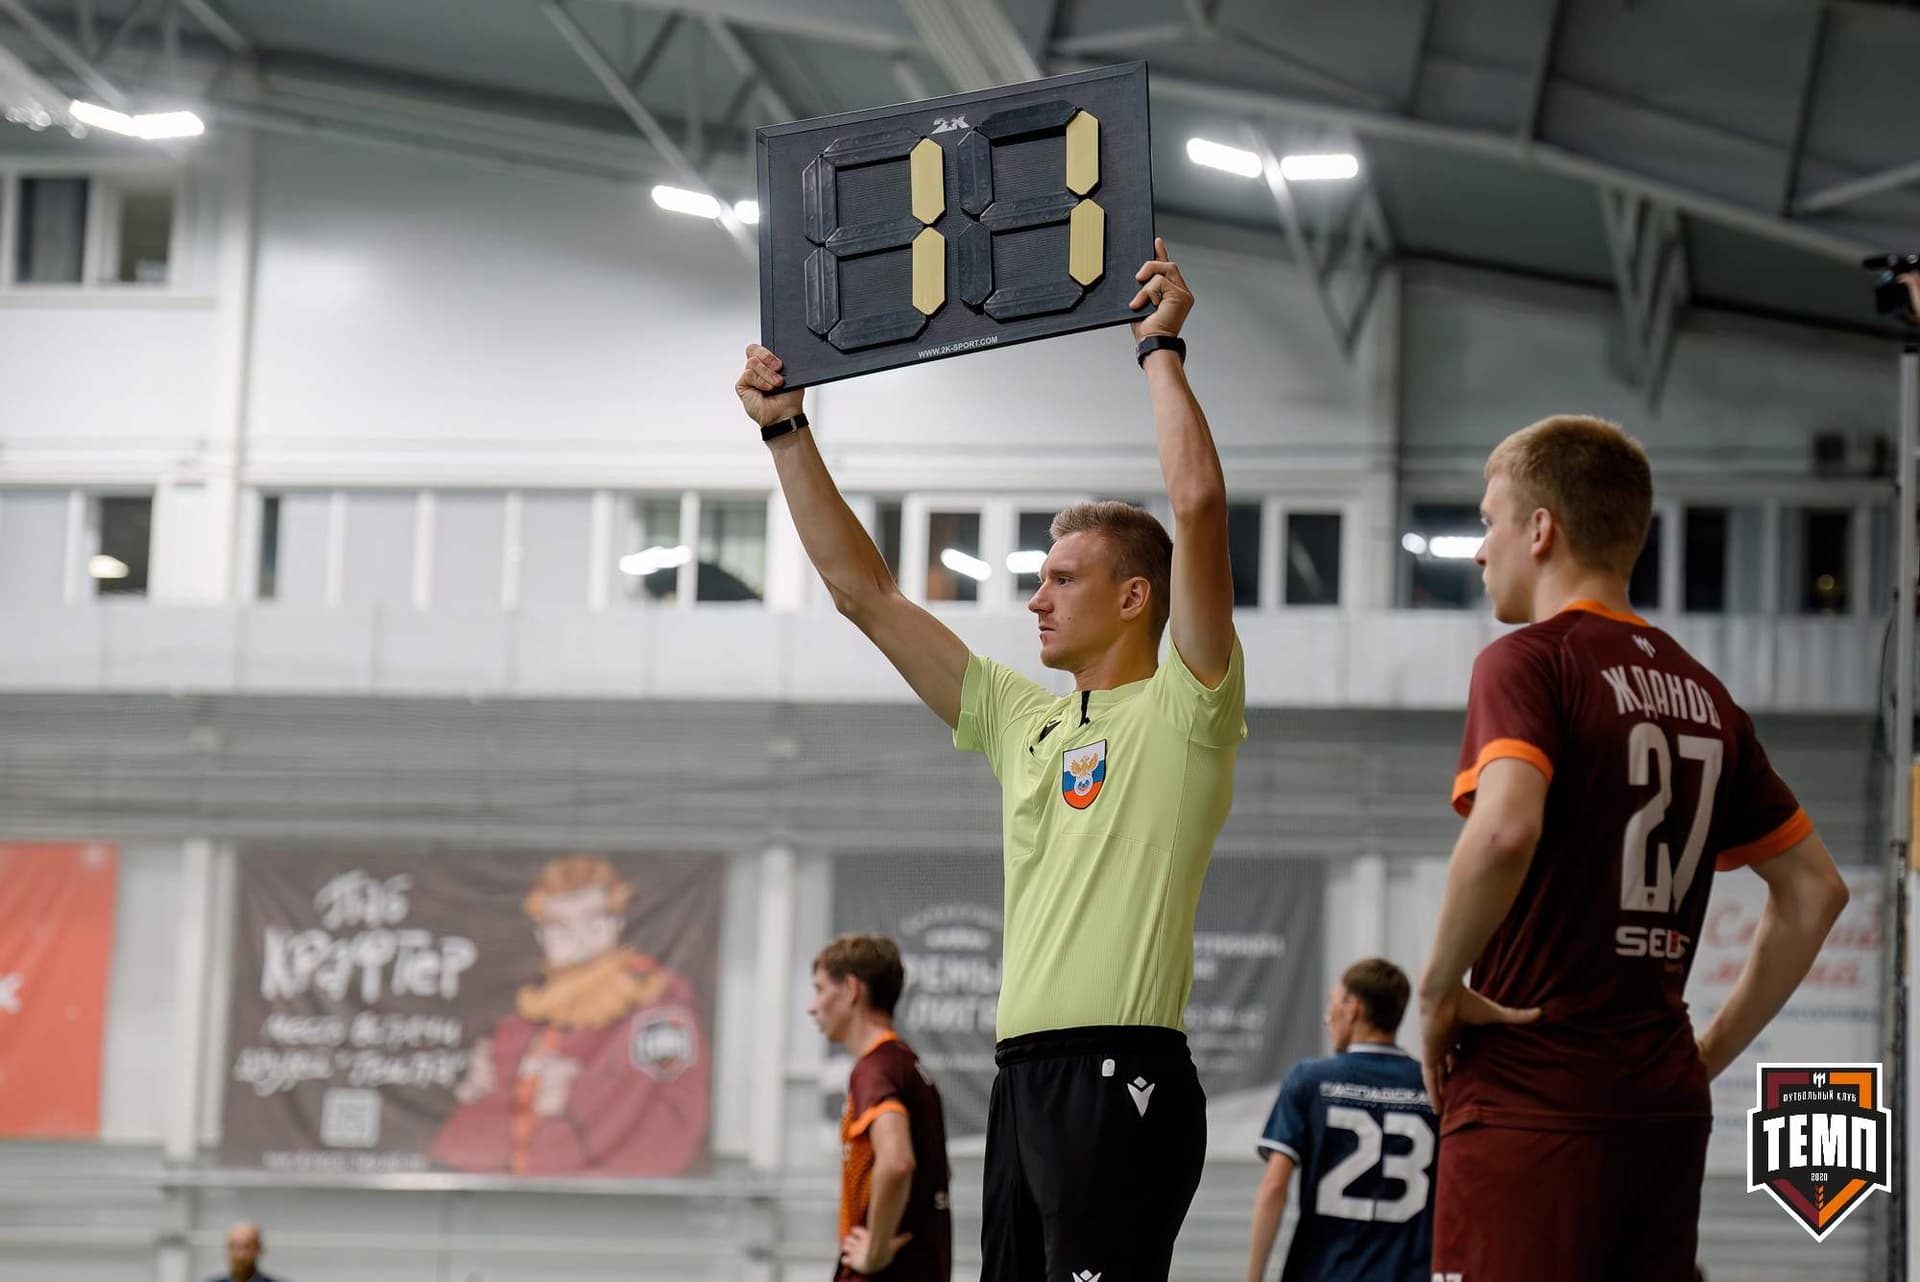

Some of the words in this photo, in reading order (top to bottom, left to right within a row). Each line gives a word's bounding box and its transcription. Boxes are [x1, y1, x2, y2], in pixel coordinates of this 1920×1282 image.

[918, 336, 998, 359] WWW.2K-SPORT.COM
[1601, 665, 1722, 731] ЖДАНОВ
[1620, 722, 1724, 914] 27
[1316, 1106, 1435, 1223] 23
